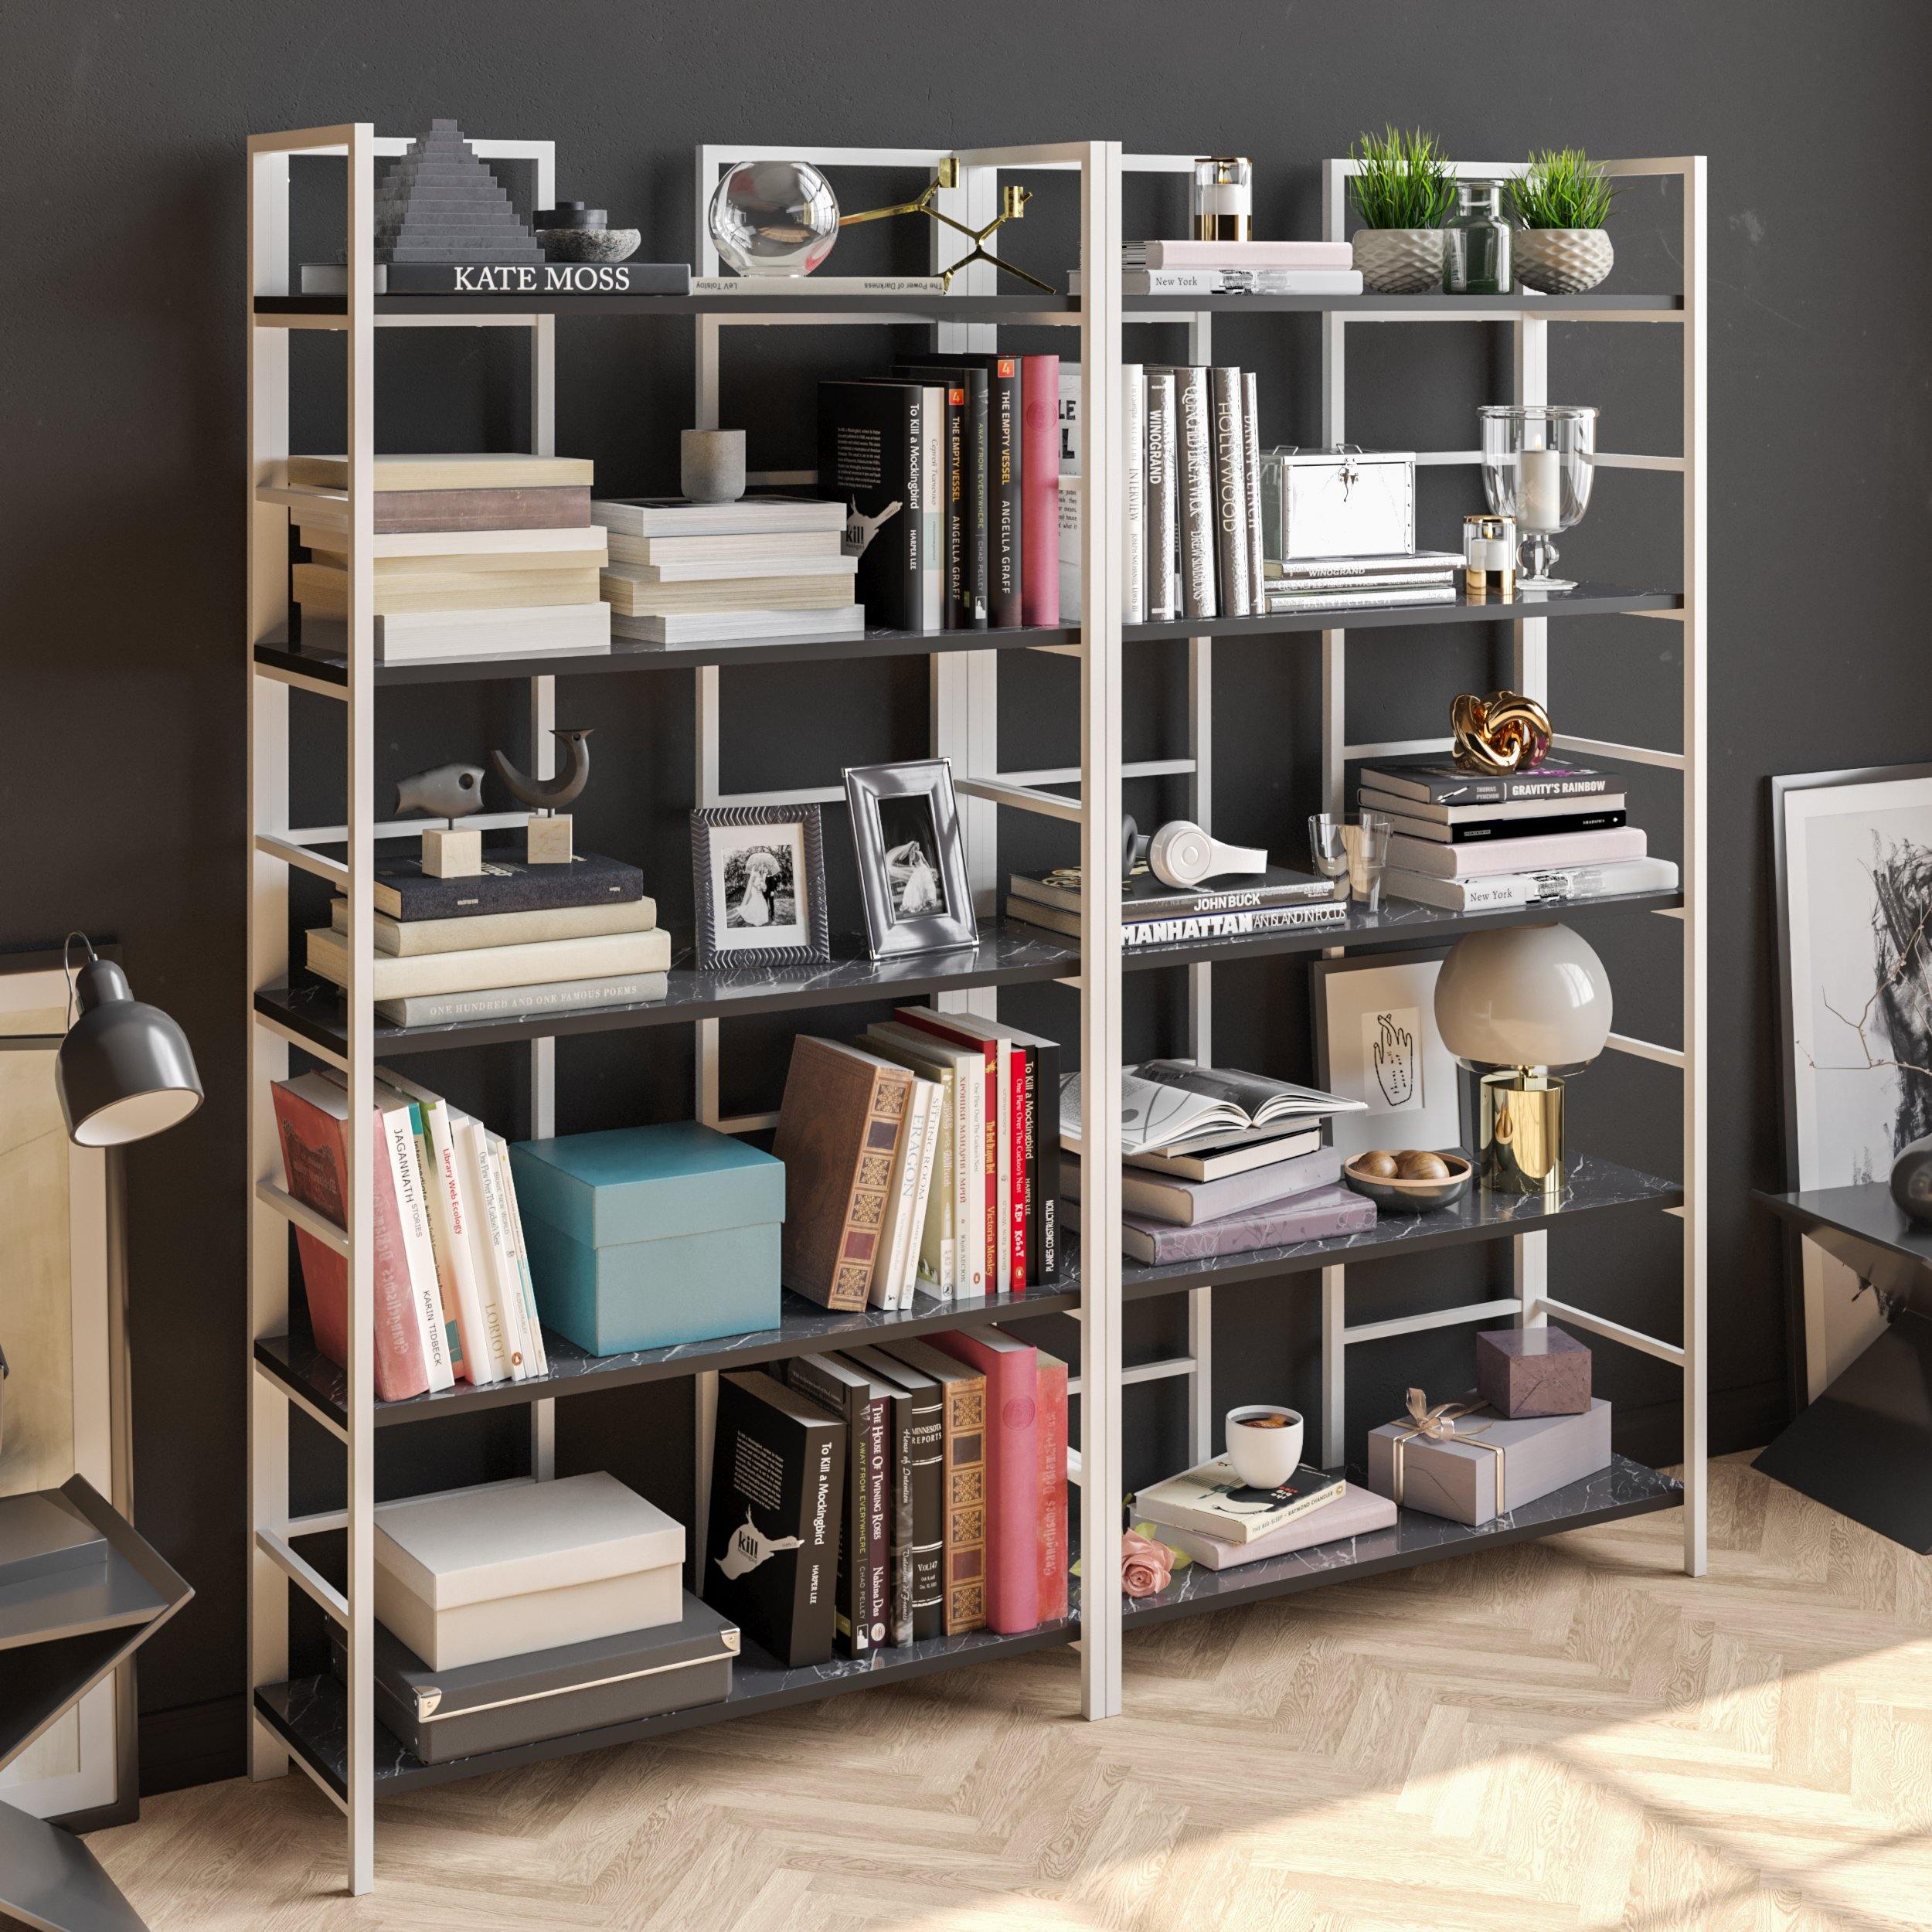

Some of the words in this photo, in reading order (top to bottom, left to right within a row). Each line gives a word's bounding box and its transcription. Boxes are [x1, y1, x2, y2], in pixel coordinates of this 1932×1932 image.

[454, 267, 537, 291] KATE
[544, 267, 630, 291] MOSS
[696, 282, 722, 291] Tolstoy
[1155, 277, 1175, 286] New
[1178, 277, 1198, 287] York
[1002, 362, 1010, 375] 4
[910, 403, 920, 417] To
[952, 391, 960, 403] 4
[1002, 390, 1010, 410] THE
[910, 418, 920, 435] Kill
[1002, 413, 1010, 447] EMPTY
[1182, 386, 1199, 447] QUENCHED
[1149, 410, 1162, 485] WINOGRAND
[1243, 415, 1253, 464] DANNY
[1002, 446, 1010, 485] VESSEL
[1187, 450, 1200, 472] LIKE
[1218, 403, 1237, 532] HOLLYWOOD
[907, 445, 920, 509] Mockingbird
[952, 470, 961, 503] VESSEL
[1189, 474, 1201, 484] A
[1128, 468, 1139, 521] INTERVIEW
[1189, 487, 1203, 517] WICK
[1246, 471, 1256, 529] CLINCH
[846, 526, 864, 543] kill
[1002, 500, 1010, 553] ANGELLA
[1191, 531, 1203, 558] DREW
[1002, 556, 1010, 594] GRAFF
[1192, 557, 1205, 600] SIMMONS
[1308, 568, 1366, 577] WINOGRAND
[1512, 783, 1560, 796] GRAVITY'S
[1562, 781, 1606, 794] RAINBOW
[1470, 893, 1490, 903] New
[1492, 889, 1513, 900] York
[1121, 913, 1253, 946] MANHATTAN
[1316, 907, 1346, 921] FOCUS
[430, 1005, 452, 1016] ONE
[456, 1001, 508, 1013] HUNDRED
[512, 997, 532, 1008] AND
[536, 994, 557, 1005] ONE
[561, 989, 600, 1002] FAMOUS
[604, 985, 638, 997] POEMS
[1026, 1061, 1034, 1073] To
[1026, 1075, 1034, 1090] Kill
[926, 1097, 940, 1153] SITTING
[985, 1120, 995, 1131] The
[985, 1131, 995, 1143] Red
[1026, 1100, 1034, 1159] Mockingbird
[442, 1148, 453, 1179] Library
[478, 1151, 487, 1165] One
[903, 1114, 924, 1197] ERAGON
[985, 1143, 995, 1163] Dragon
[393, 1128, 414, 1204] JAGANNATH
[411, 1202, 423, 1238] STORIES
[448, 1179, 457, 1200] Web
[918, 1155, 931, 1200] ROOM
[451, 1201, 462, 1235] Ecology
[488, 1206, 498, 1232] Cuckoo's
[497, 1193, 505, 1209] NEW
[501, 1210, 509, 1235] WORLD
[986, 1206, 995, 1243] Victoria
[1046, 1199, 1054, 1248] CONSTRUCTION
[492, 1230, 501, 1246] Nest
[985, 1245, 995, 1277] Mosley
[1046, 1248, 1054, 1272] PLANES
[423, 1290, 434, 1321] KARIN
[428, 1323, 441, 1366] TIDBECK
[485, 1301, 505, 1362] LORIOT
[872, 1404, 883, 1424] THE
[872, 1426, 883, 1454] HOUSE
[903, 1428, 911, 1454] House
[911, 1423, 943, 1436] MINNESOTA
[911, 1432, 943, 1444] REPORTS
[821, 1442, 832, 1455] To
[900, 1454, 911, 1465] of
[821, 1457, 832, 1473] Kill
[872, 1456, 883, 1471] OF
[872, 1471, 883, 1512] TWINING
[903, 1467, 911, 1504] Intention
[813, 1482, 829, 1546] Mockingbird
[1261, 1521, 1270, 1530] BIG
[1270, 1515, 1283, 1526] SLEEP
[1287, 1502, 1311, 1517] RAYMOND
[1311, 1490, 1335, 1506] CHANDLER
[872, 1513, 883, 1540] ROSES
[738, 1530, 758, 1559] kill
[810, 1564, 820, 1591] HARPER
[872, 1566, 884, 1598] Nabina
[872, 1598, 884, 1617] Das
